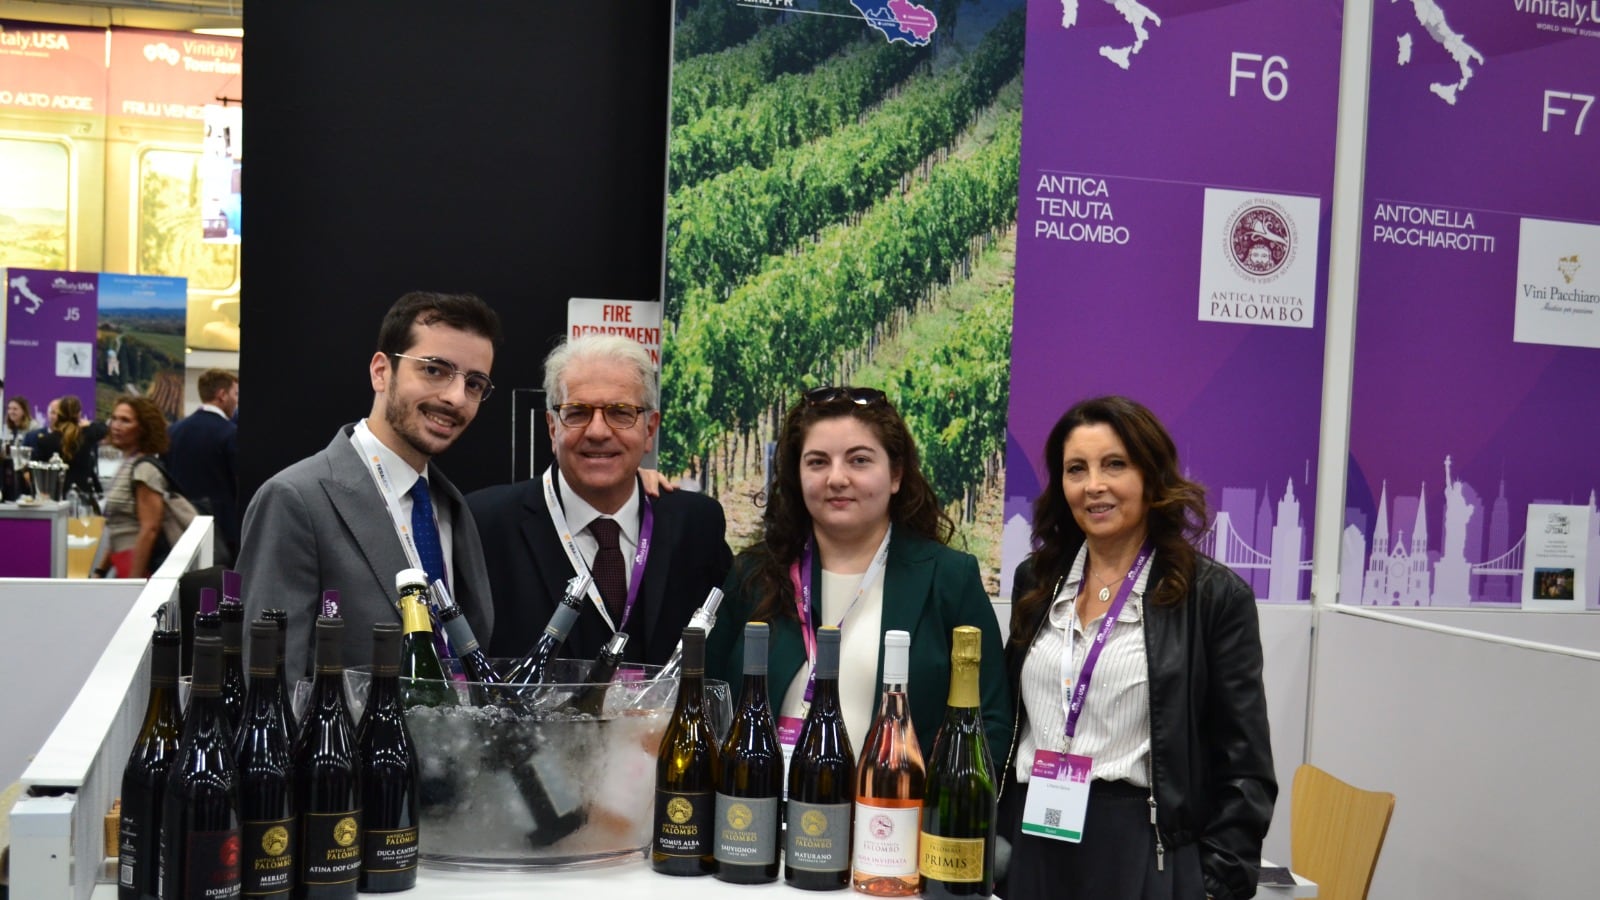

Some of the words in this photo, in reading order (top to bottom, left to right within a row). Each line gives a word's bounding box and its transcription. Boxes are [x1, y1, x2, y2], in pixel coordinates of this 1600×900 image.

[1536, 23, 1560, 32] WORLD
[1561, 26, 1578, 35] WINE
[183, 40, 237, 61] Vinitaly
[182, 56, 241, 75] Tourism
[1230, 51, 1289, 101] F6
[15, 91, 50, 107] ALTO
[1542, 89, 1595, 135] F7
[1036, 174, 1109, 198] ANTICA
[1036, 197, 1114, 221] TENUTA
[1374, 203, 1475, 230] ANTONELLA
[1035, 220, 1130, 245] PALOMBO
[1373, 225, 1495, 253] PACCHIAROTTI
[1211, 291, 1255, 302] ANTICA
[1259, 294, 1304, 306] TENUTA
[1523, 284, 1547, 300] Vini
[64, 307, 81, 321] J5
[603, 304, 632, 323] FIRE
[1210, 301, 1304, 322] PALOMBO
[662, 827, 698, 835] PALOMBO
[660, 837, 682, 846] DOMUS
[721, 844, 757, 853] SAUVIGNON
[794, 852, 832, 860] MATURANO
[925, 853, 967, 869] PRIMIS
[260, 873, 288, 882] MERLOT
[205, 887, 233, 897] DOMUS
